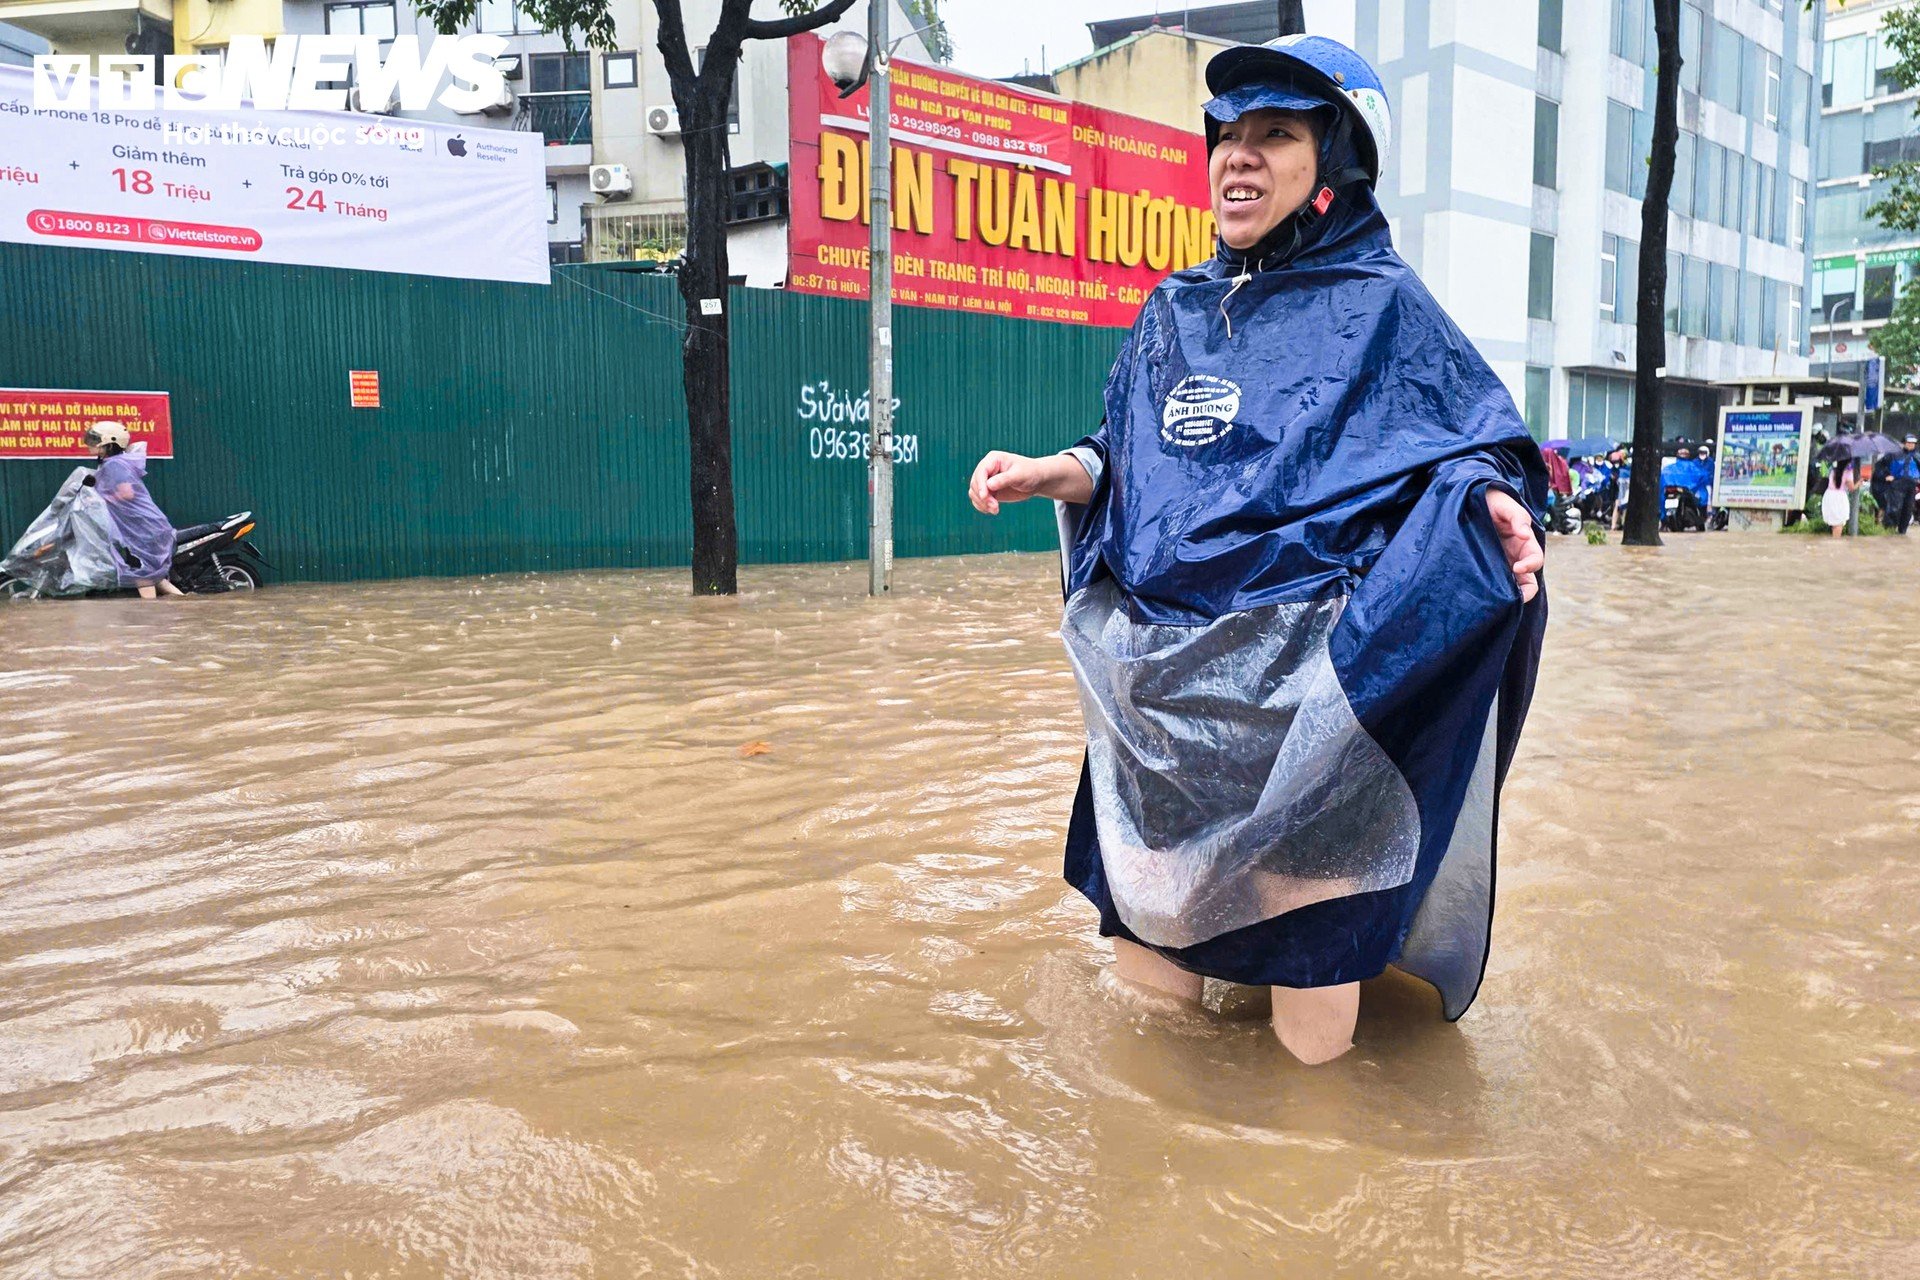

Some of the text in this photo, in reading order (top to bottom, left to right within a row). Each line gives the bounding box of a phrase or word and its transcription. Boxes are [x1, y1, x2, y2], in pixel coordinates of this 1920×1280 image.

[0, 98, 30, 115] cấp
[91, 111, 111, 125] 18
[114, 114, 140, 129] Pro
[143, 116, 162, 131] dễ
[476, 142, 518, 155] Authorized
[971, 131, 1000, 147] 0988
[1003, 137, 1026, 151] 832
[1108, 133, 1157, 158] HOÀNG
[1160, 146, 1188, 165] ANH
[112, 144, 207, 168] Giảm thêm
[476, 152, 506, 162] Reseller
[0, 165, 39, 186] riệu
[111, 167, 155, 195] 18
[162, 182, 212, 203] Triệu
[280, 163, 390, 189] Trả góp 0% tới
[285, 186, 388, 222] 24 Tháng
[818, 132, 934, 235] ĐN
[1087, 185, 1218, 273] HƯƠNG
[57, 217, 256, 246] 1800 8123 Viettelstore.vn
[817, 243, 870, 270] CHUYÊ
[894, 251, 925, 277] ĐÈN
[929, 259, 977, 283] TRANG
[981, 264, 1003, 288] TRÍ
[1036, 275, 1075, 300] NGOẠI
[1118, 283, 1142, 305] CÁC
[924, 291, 946, 305] NAM
[984, 297, 996, 310] HÀ
[12, 402, 28, 417] TỰ
[40, 401, 63, 415] PHÁ
[83, 403, 113, 415] HÀNG
[0, 417, 21, 431] ÀM
[23, 420, 40, 431] HƯ
[42, 420, 61, 433] HẠI
[64, 418, 81, 431] TÀI
[143, 419, 155, 432] LÝ
[0, 436, 17, 447] NH
[19, 432, 43, 447] CỦA
[45, 435, 75, 447] PHÁP
